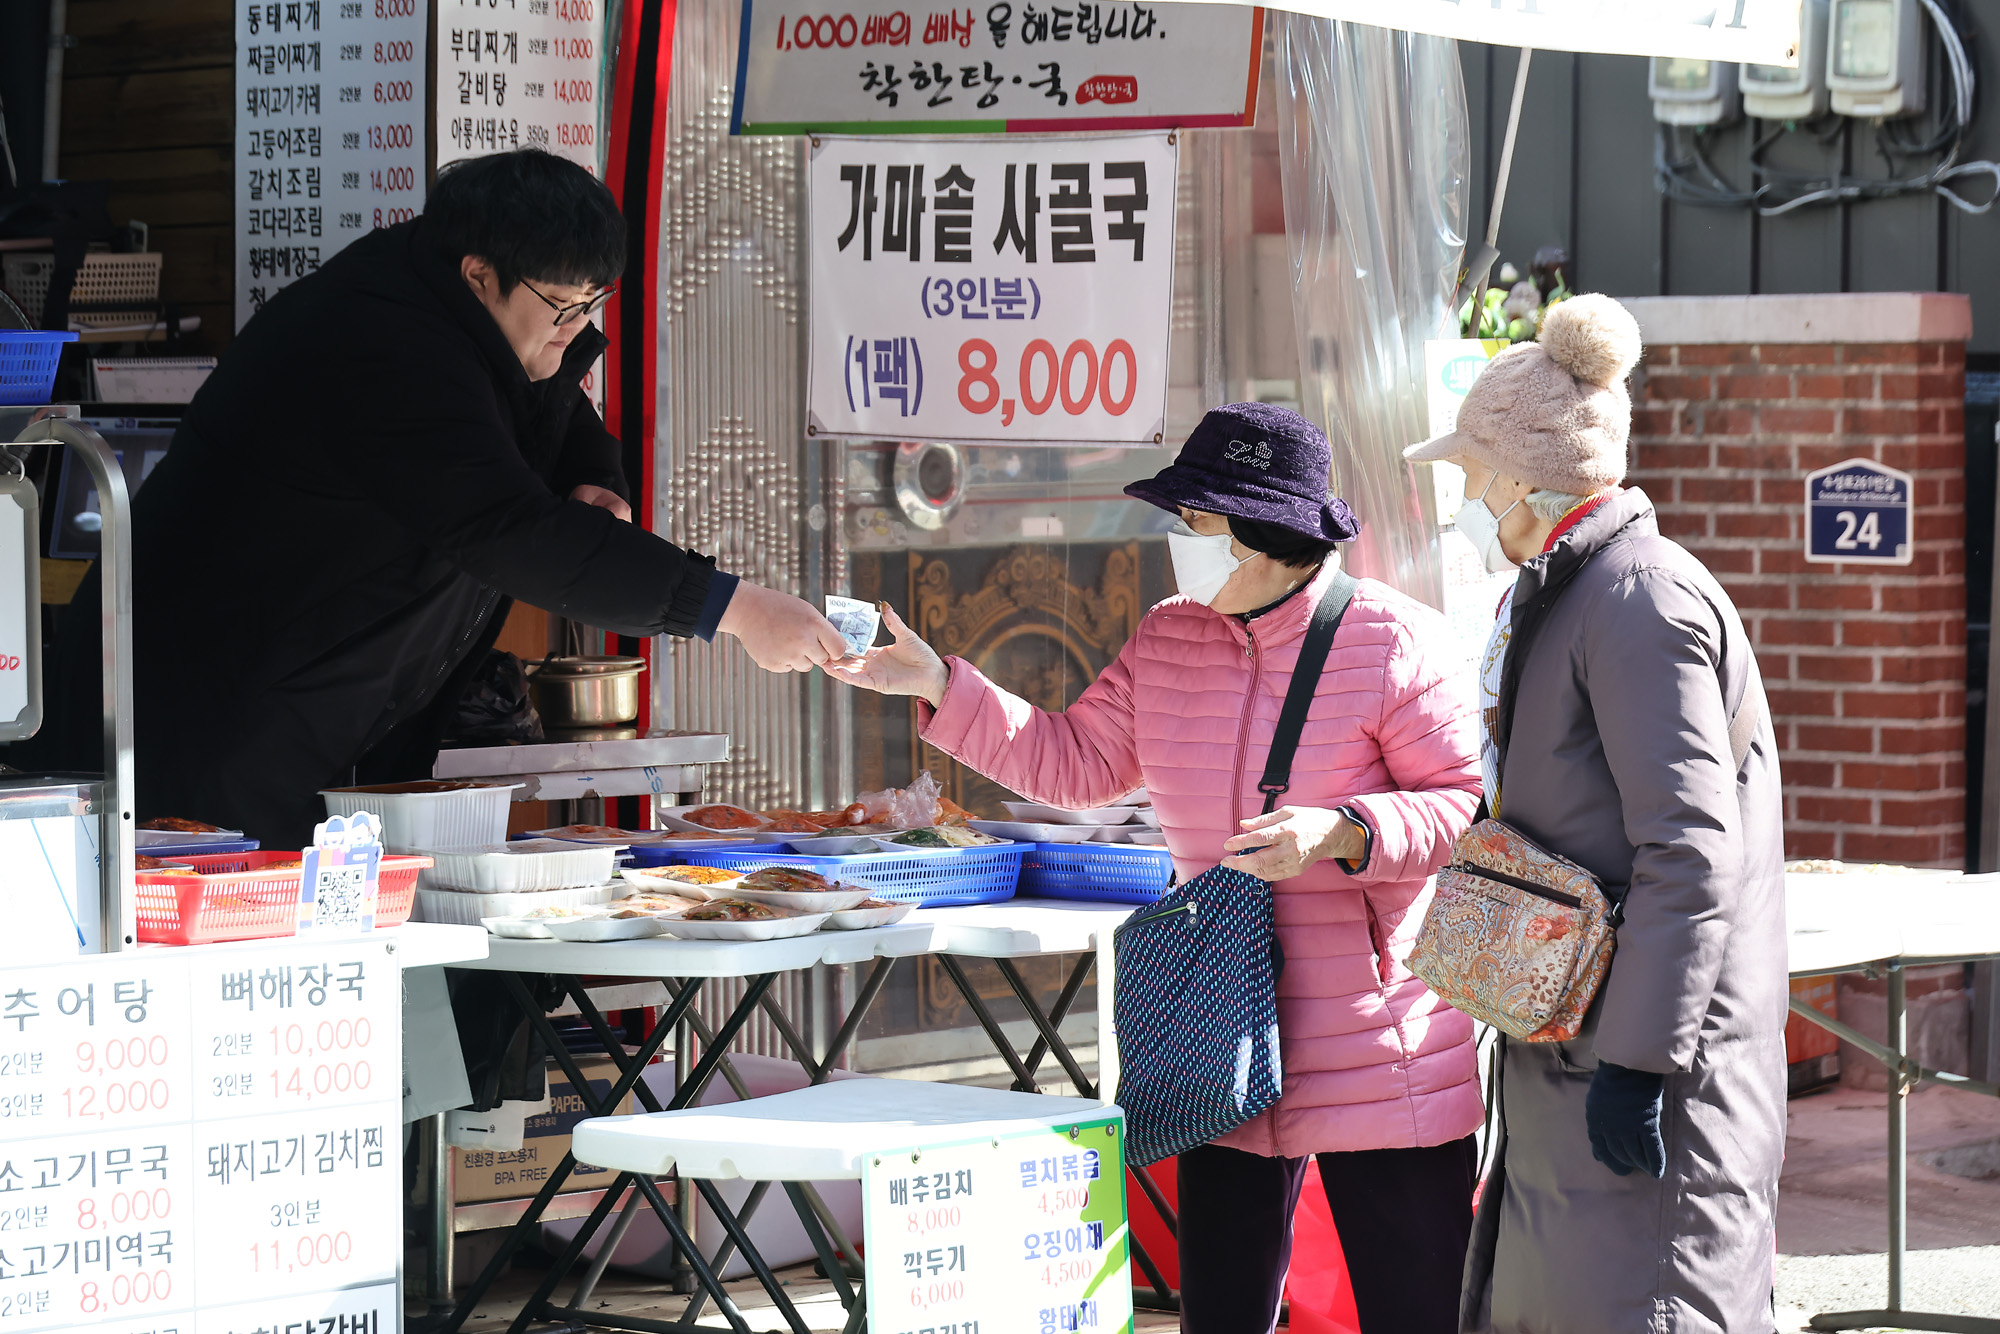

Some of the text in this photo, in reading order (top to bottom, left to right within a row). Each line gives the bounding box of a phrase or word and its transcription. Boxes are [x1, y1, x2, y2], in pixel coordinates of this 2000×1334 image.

[248, 1, 320, 35] 동태찌개
[375, 0, 415, 20] 8,000
[554, 0, 594, 23] 14,000
[247, 40, 413, 75] 짜글이찌개 2인분 8,000
[451, 28, 518, 64] 부대찌개
[554, 38, 593, 60] 11,000
[339, 88, 362, 102] 2인분
[374, 80, 413, 104] 6,000
[458, 71, 593, 106] 갈비탕 2인분 14,000
[248, 126, 321, 160] 고등어조림
[367, 124, 413, 151] 13,000
[526, 125, 549, 144] 350g
[557, 123, 594, 148] 18,000
[248, 166, 321, 200] 갈치조림
[370, 167, 414, 195] 14,000
[248, 206, 322, 238] 코다리조림
[339, 213, 362, 228] 2인분
[838, 161, 1149, 263] 가마솥 사골국
[249, 247, 321, 278] 황태해장국
[921, 277, 1041, 320] (3인분)
[844, 335, 1137, 427] (1팩) 8,000
[1224, 440, 1270, 470] Love
[1835, 511, 1882, 550] 24
[3, 979, 153, 1031] 추어탕
[221, 961, 365, 1011] 뼈해장국
[0, 1035, 168, 1076] 2인분 9,000
[213, 1017, 371, 1057] 2인분 10,000
[0, 1078, 169, 1121] 3인분 12,000
[213, 1060, 371, 1101] 3인분 14,000
[0, 1145, 169, 1192] 소고기무국
[464, 1153, 494, 1169] 친환경
[494, 1168, 547, 1185] BPA FREE
[889, 1149, 1099, 1205] 배추김치 멸치볶음
[1, 1188, 171, 1231] 2인분 8,000
[270, 1199, 321, 1227] 3인분
[907, 1187, 1089, 1235] 8,000 4,500
[250, 1231, 352, 1273] 11,000
[904, 1221, 1103, 1278] 깍두기 오징어채
[2, 1270, 172, 1317] 2인분 8,000
[910, 1259, 1092, 1310] 6,000 4,500
[1039, 1301, 1098, 1334] 황태채
